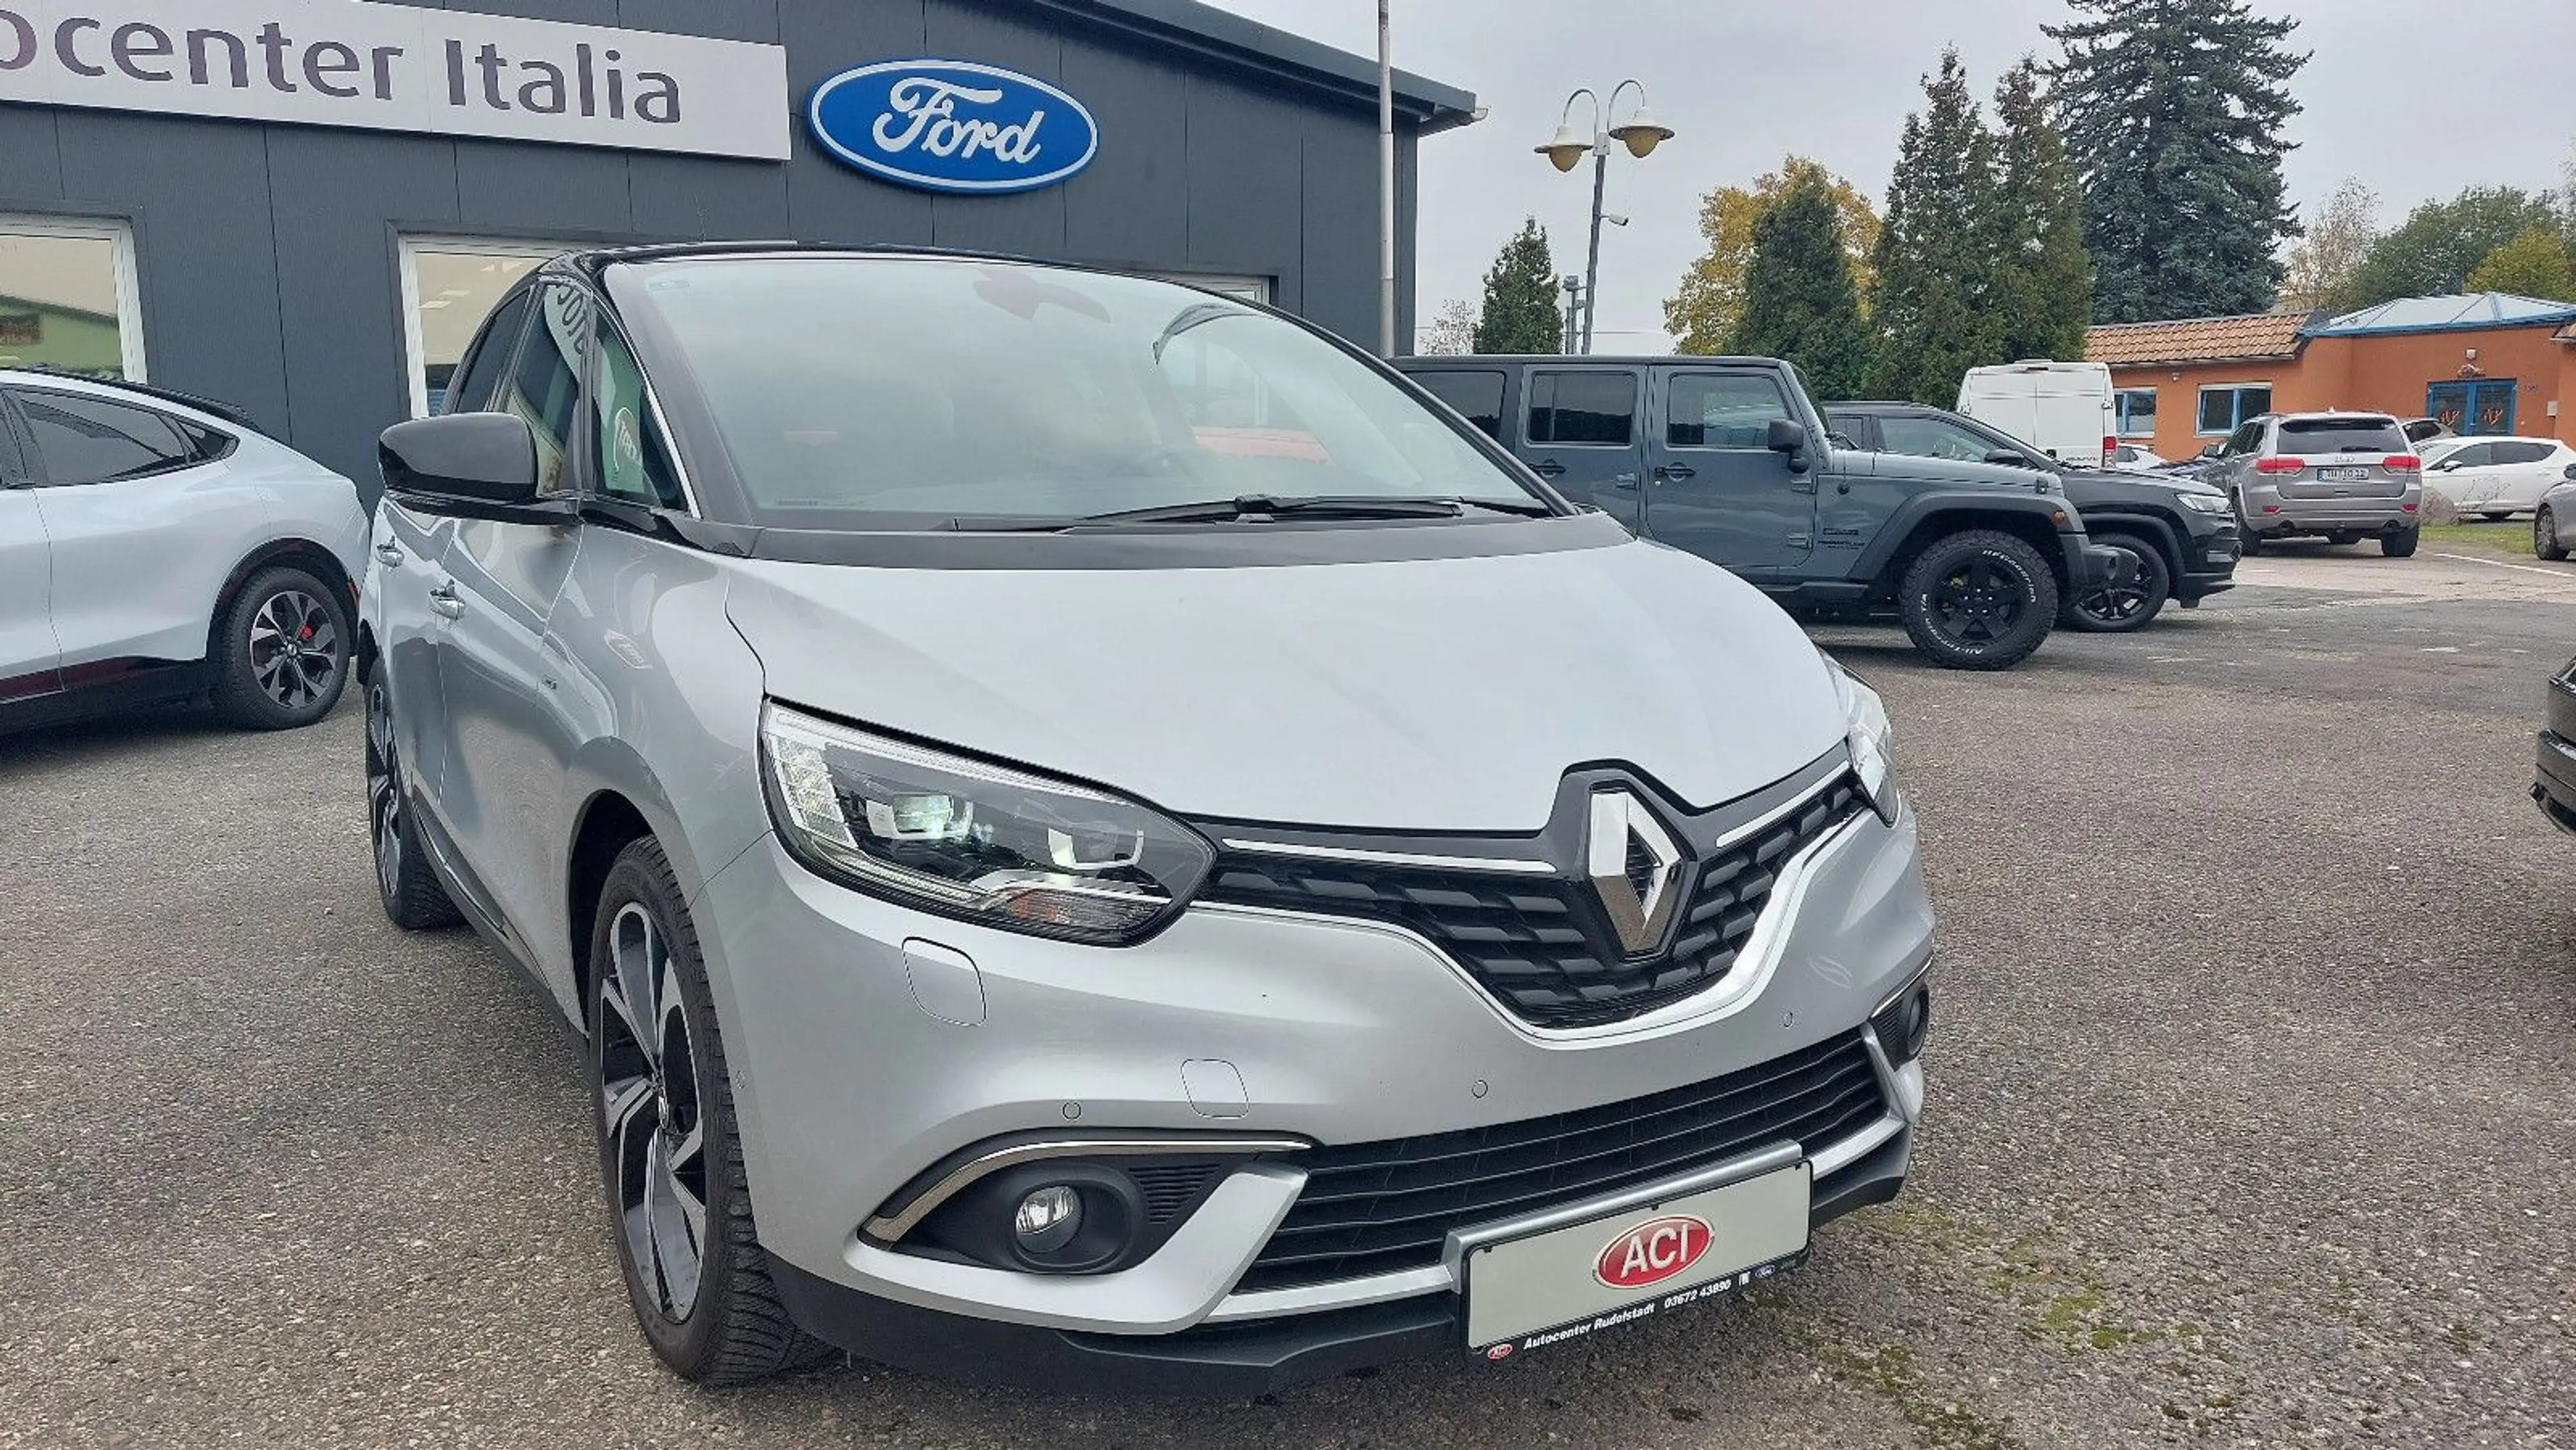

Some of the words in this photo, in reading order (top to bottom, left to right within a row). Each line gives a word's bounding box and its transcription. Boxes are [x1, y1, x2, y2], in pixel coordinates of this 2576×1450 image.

[445, 38, 680, 123] Italia
[873, 77, 1044, 163] Ford
[1620, 1223, 1688, 1279] ACI
[1523, 1323, 1592, 1350] Autocenter
[1593, 1302, 1656, 1331] Rudolstadt
[1664, 1289, 1698, 1308] 03672
